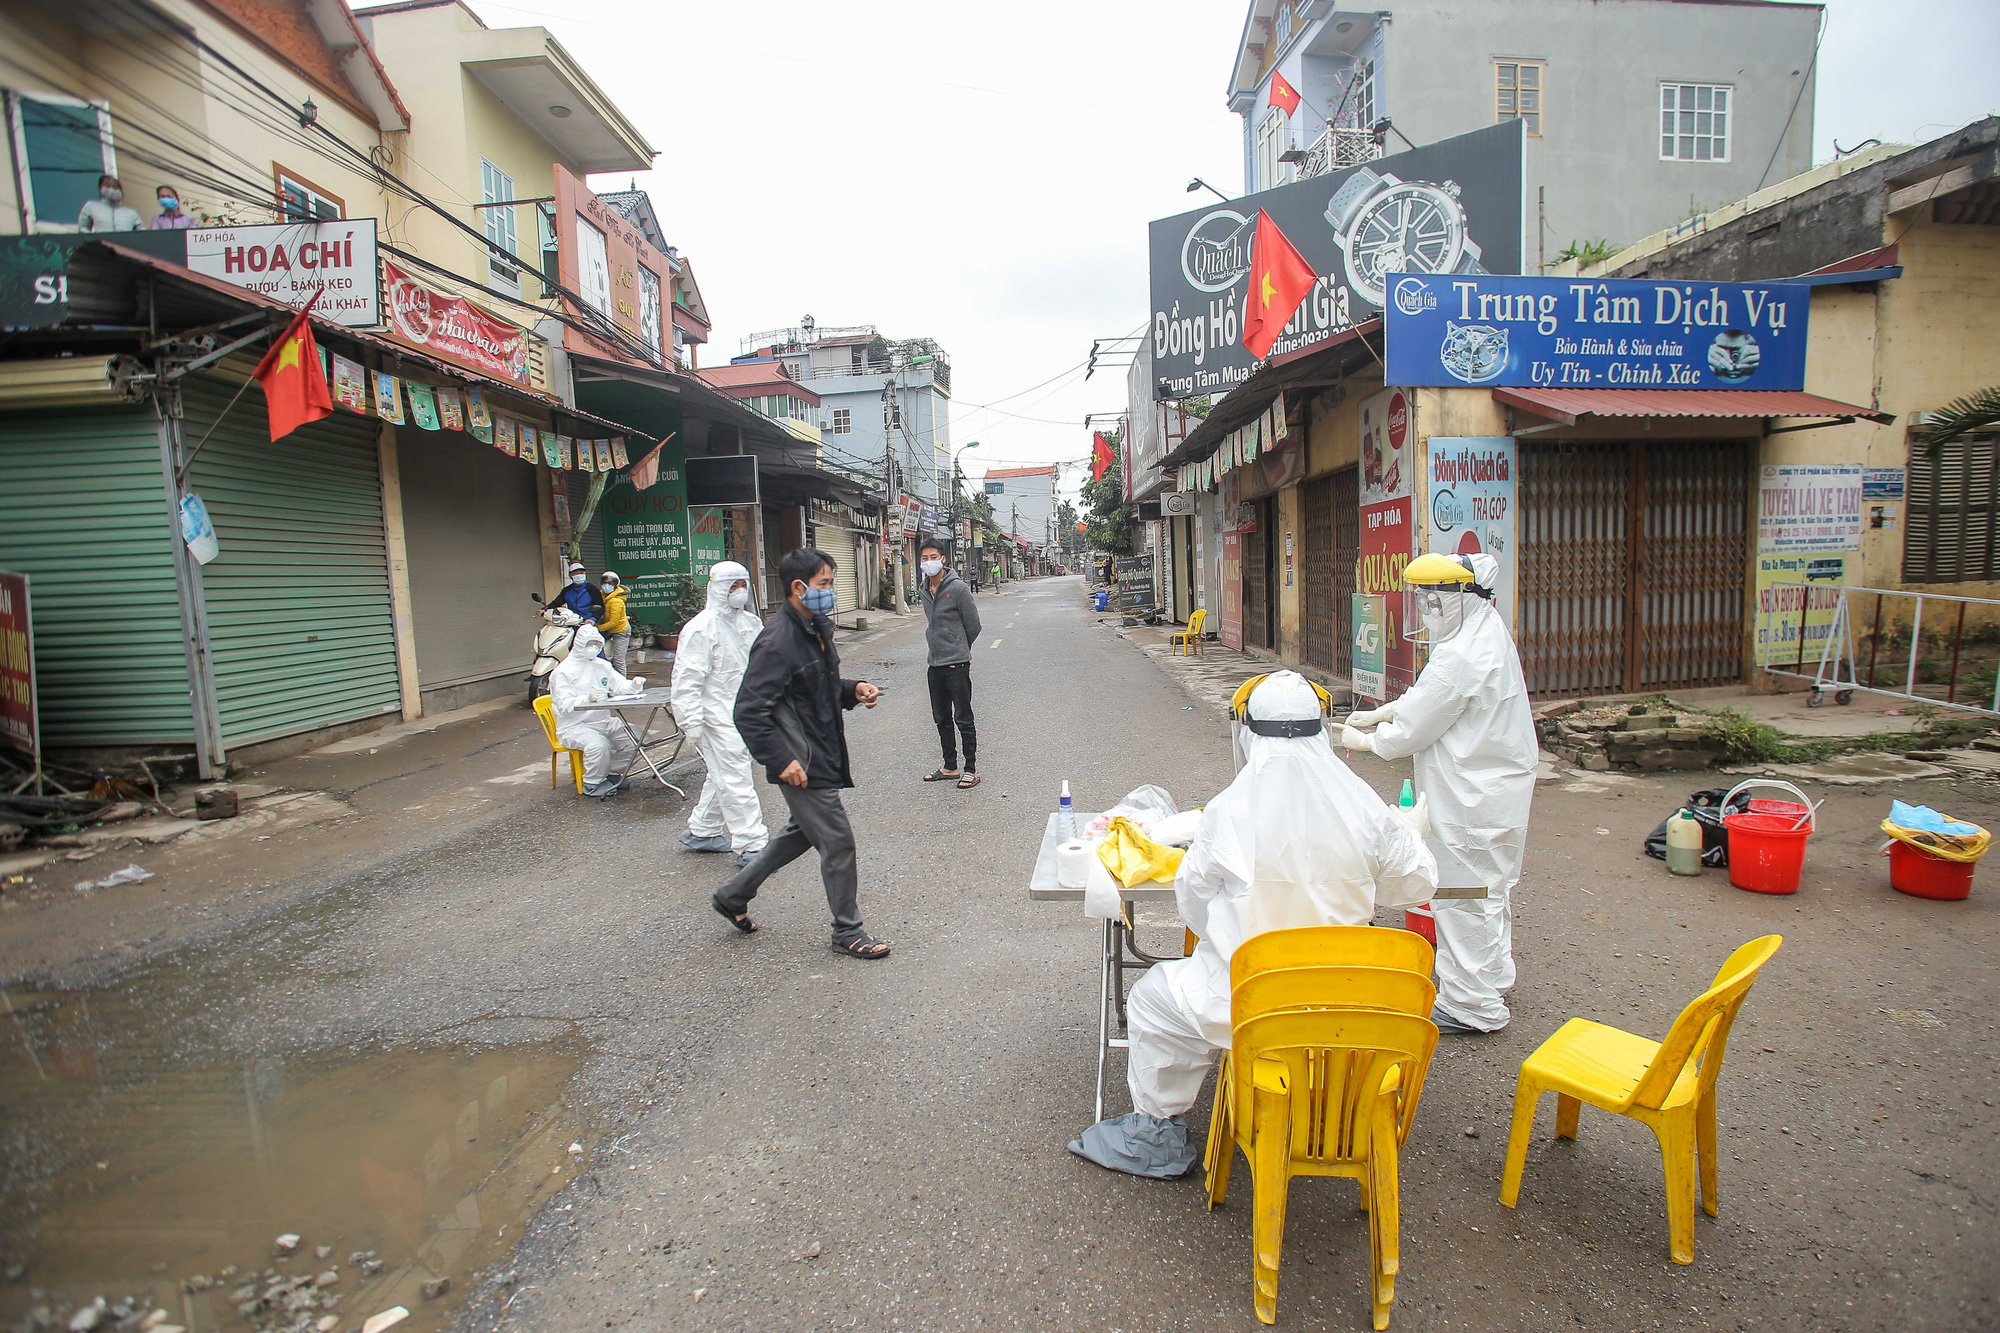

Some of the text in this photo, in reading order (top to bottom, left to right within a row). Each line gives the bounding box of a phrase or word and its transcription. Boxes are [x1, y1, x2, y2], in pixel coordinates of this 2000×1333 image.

[193, 231, 236, 245] TẠP HÓA
[225, 231, 353, 273] HOA CHÍ
[1195, 236, 1242, 284] Quach
[291, 276, 324, 292] BÁNH
[328, 278, 353, 291] KẸO
[310, 296, 333, 311] GIẢI
[336, 294, 369, 310] KHÁT
[1424, 292, 1437, 307] Gia
[1452, 281, 1787, 337] Trung Tâm Dịch Vụ
[1155, 300, 1205, 365] Đồng
[1210, 288, 1237, 348] Hồ
[1313, 272, 1350, 329] Gia
[1554, 338, 1683, 357] Bảo Hành & Sửa chữa
[1195, 370, 1219, 388] Tâm
[1222, 364, 1249, 383] Mua
[1530, 362, 1555, 387] Uy
[1559, 362, 1591, 384] Tín
[1608, 361, 1663, 385] Chính
[1667, 362, 1700, 386] Xác
[661, 468, 679, 481] CƯỚI
[1470, 451, 1495, 485] Quách
[1496, 451, 1509, 481] Gia
[1472, 490, 1507, 520] TRẢ GÓP
[1762, 477, 1860, 517] TUYỂN LÁI XE TAXI
[617, 520, 675, 535] CƯỚI HỎI TRỌN GÓI
[1367, 506, 1402, 532] TẠP HÓA
[613, 538, 627, 547] CHO
[628, 535, 645, 547] THUÊ
[661, 534, 671, 545] ÁO
[671, 533, 683, 545] DÀI
[617, 546, 679, 560] TRANG ĐIỂM DẠ HỘI
[1363, 542, 1409, 594] QUÁCH
[1355, 622, 1379, 654] 4G
[1356, 671, 1379, 685] ĐIỂM BÁN
[1358, 683, 1377, 695] SIM THẺ
